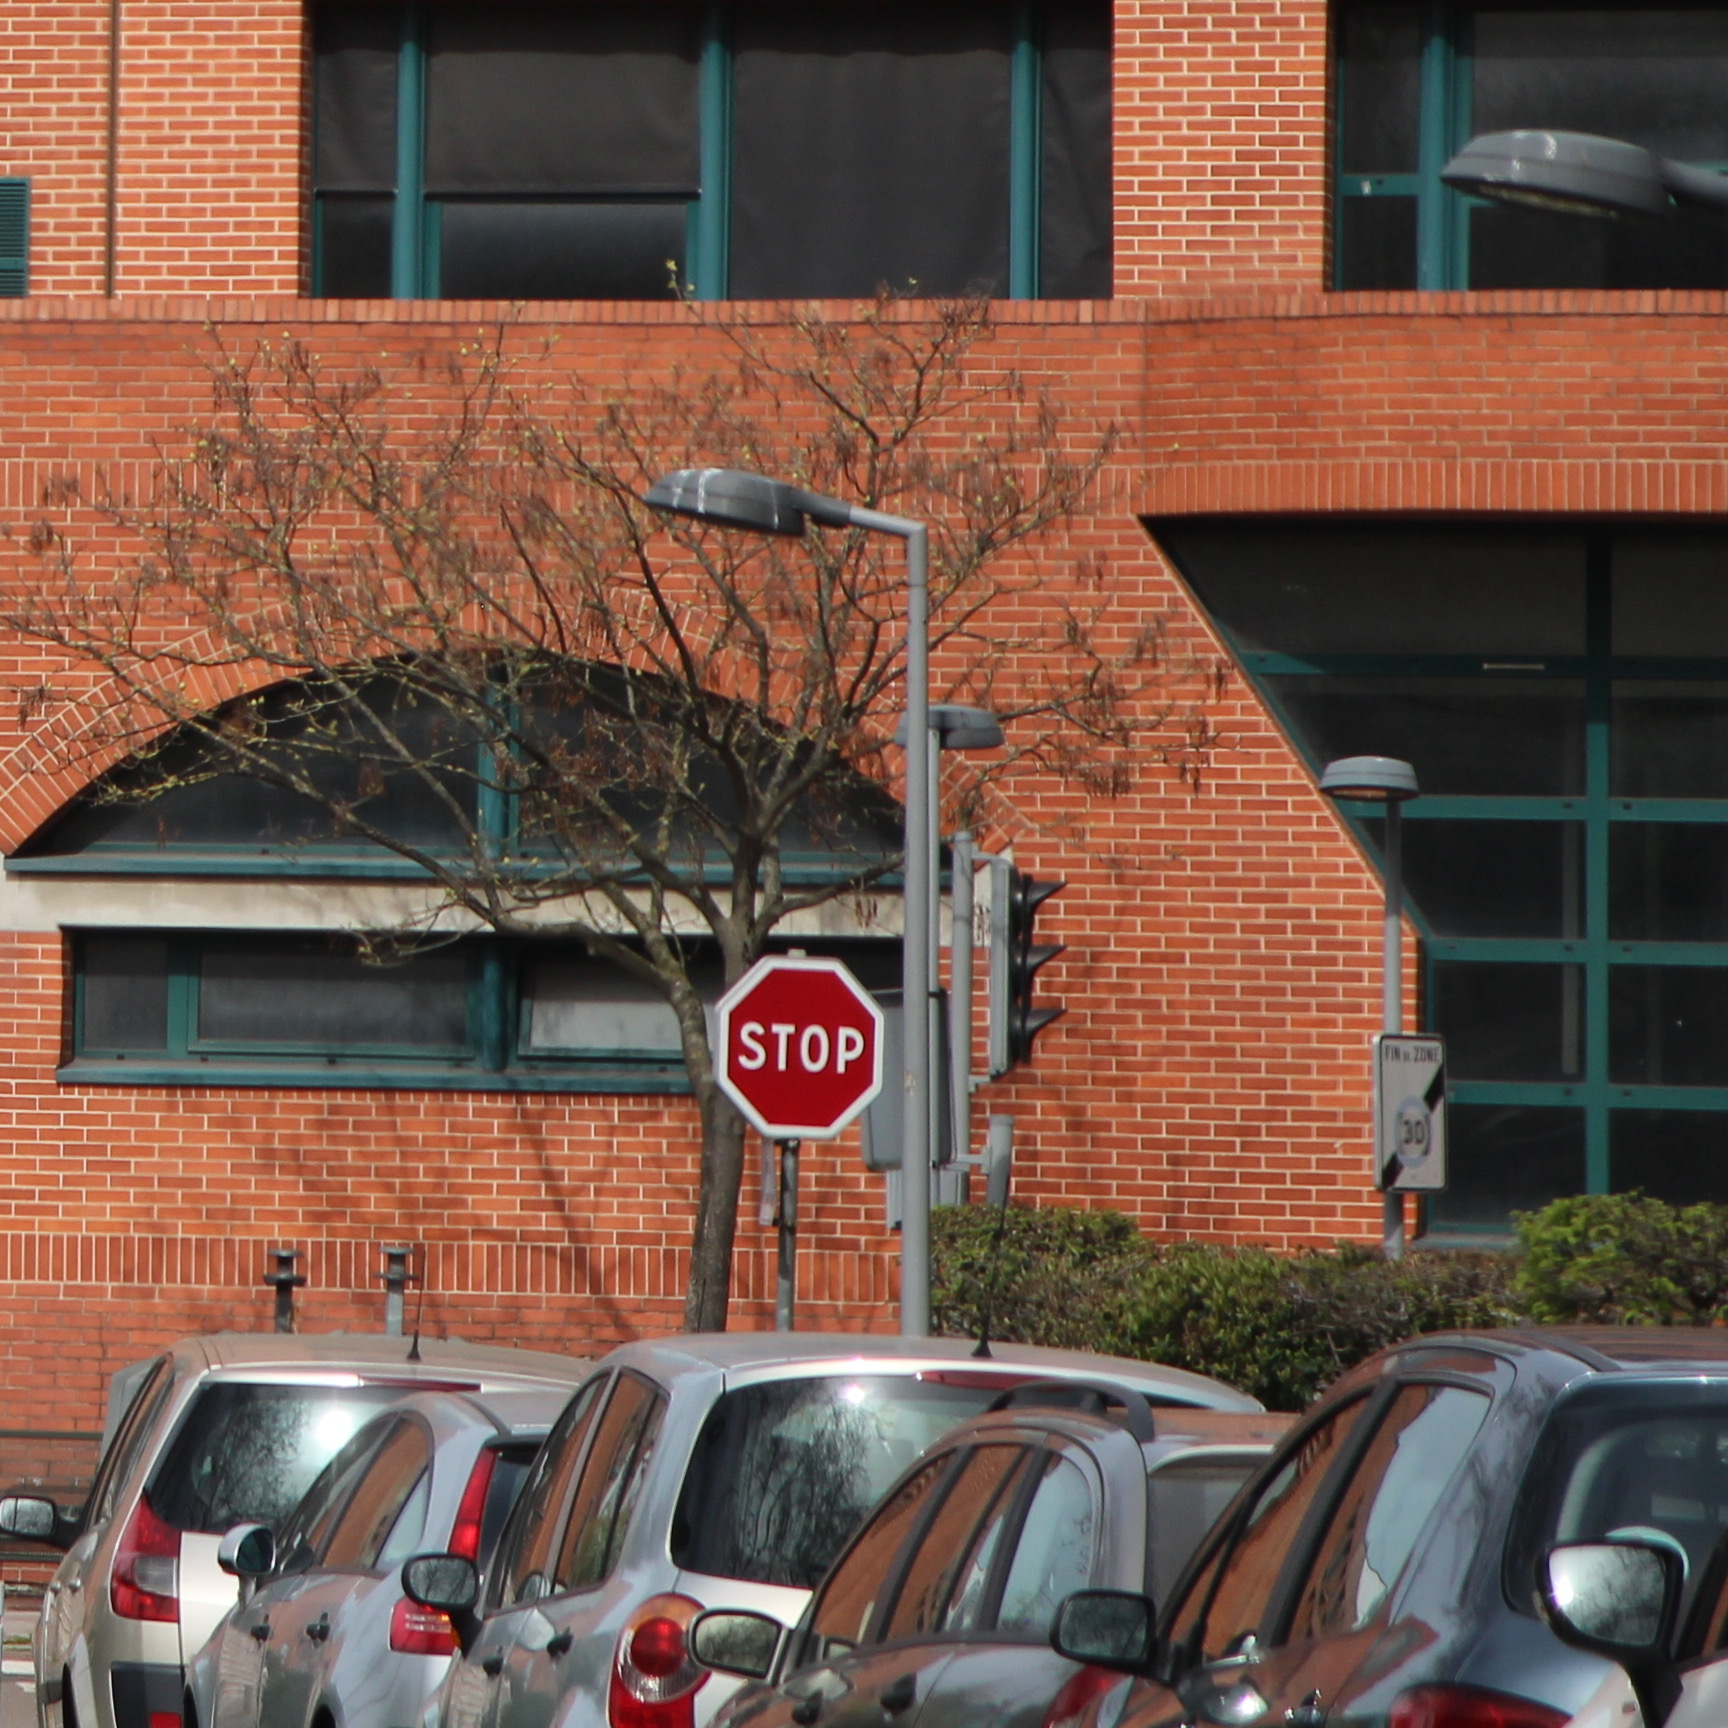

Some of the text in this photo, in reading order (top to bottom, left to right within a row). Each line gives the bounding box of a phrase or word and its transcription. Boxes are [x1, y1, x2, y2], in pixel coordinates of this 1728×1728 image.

[738, 1021, 865, 1075] STOP
[1384, 1044, 1401, 1061] FIN
[1413, 1046, 1441, 1064] ZONE
[1402, 1119, 1425, 1144] 30
